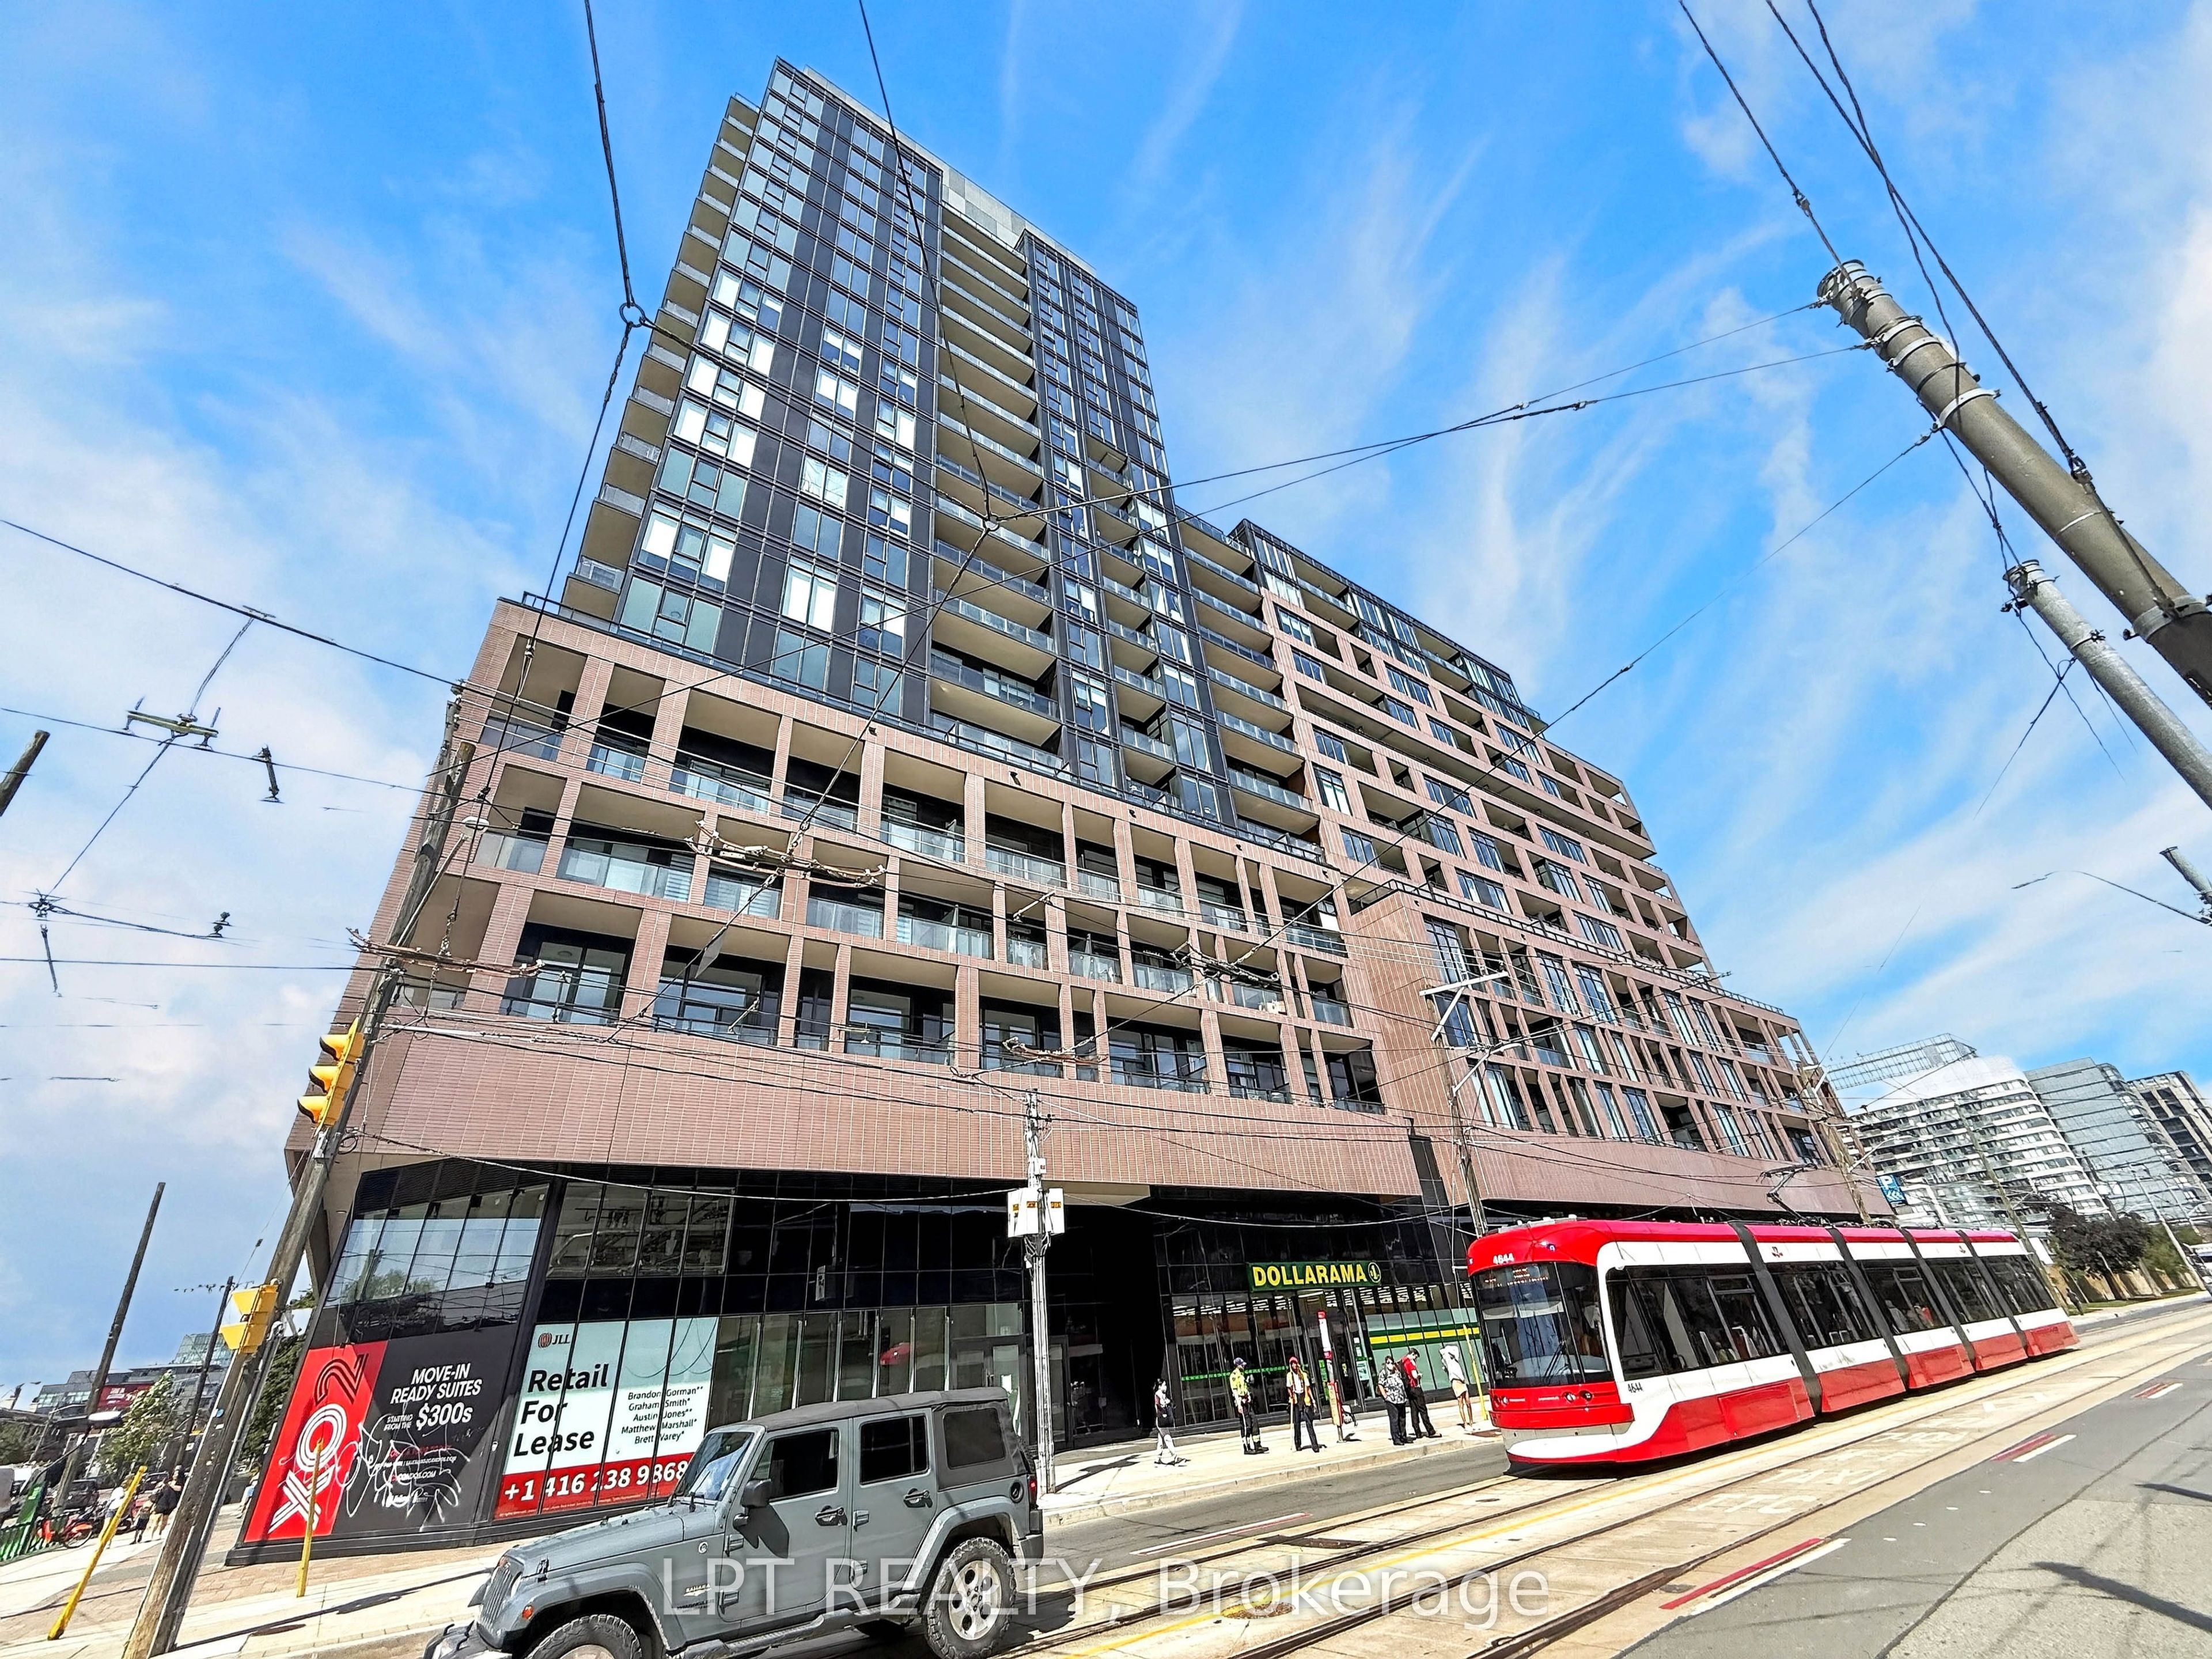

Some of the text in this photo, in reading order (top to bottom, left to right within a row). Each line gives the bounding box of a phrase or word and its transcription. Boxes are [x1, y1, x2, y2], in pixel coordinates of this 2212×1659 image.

[1252, 1264, 1368, 1286] DOLLARAMA
[552, 1334, 570, 1344] JLL
[411, 1363, 471, 1384] MOVE-IN
[528, 1363, 609, 1393] Retail
[390, 1379, 483, 1404] READY SUITES
[628, 1391, 661, 1400] Brandon
[416, 1402, 473, 1430] $300s
[520, 1400, 568, 1425] For
[628, 1402, 659, 1411] Graham
[633, 1413, 658, 1421] Austin
[622, 1425, 656, 1434] Matthew
[635, 1435, 654, 1444] Brett
[514, 1431, 594, 1457] Lease
[505, 1480, 535, 1501] +1
[545, 1474, 585, 1497] 416
[590, 1468, 631, 1492] 238
